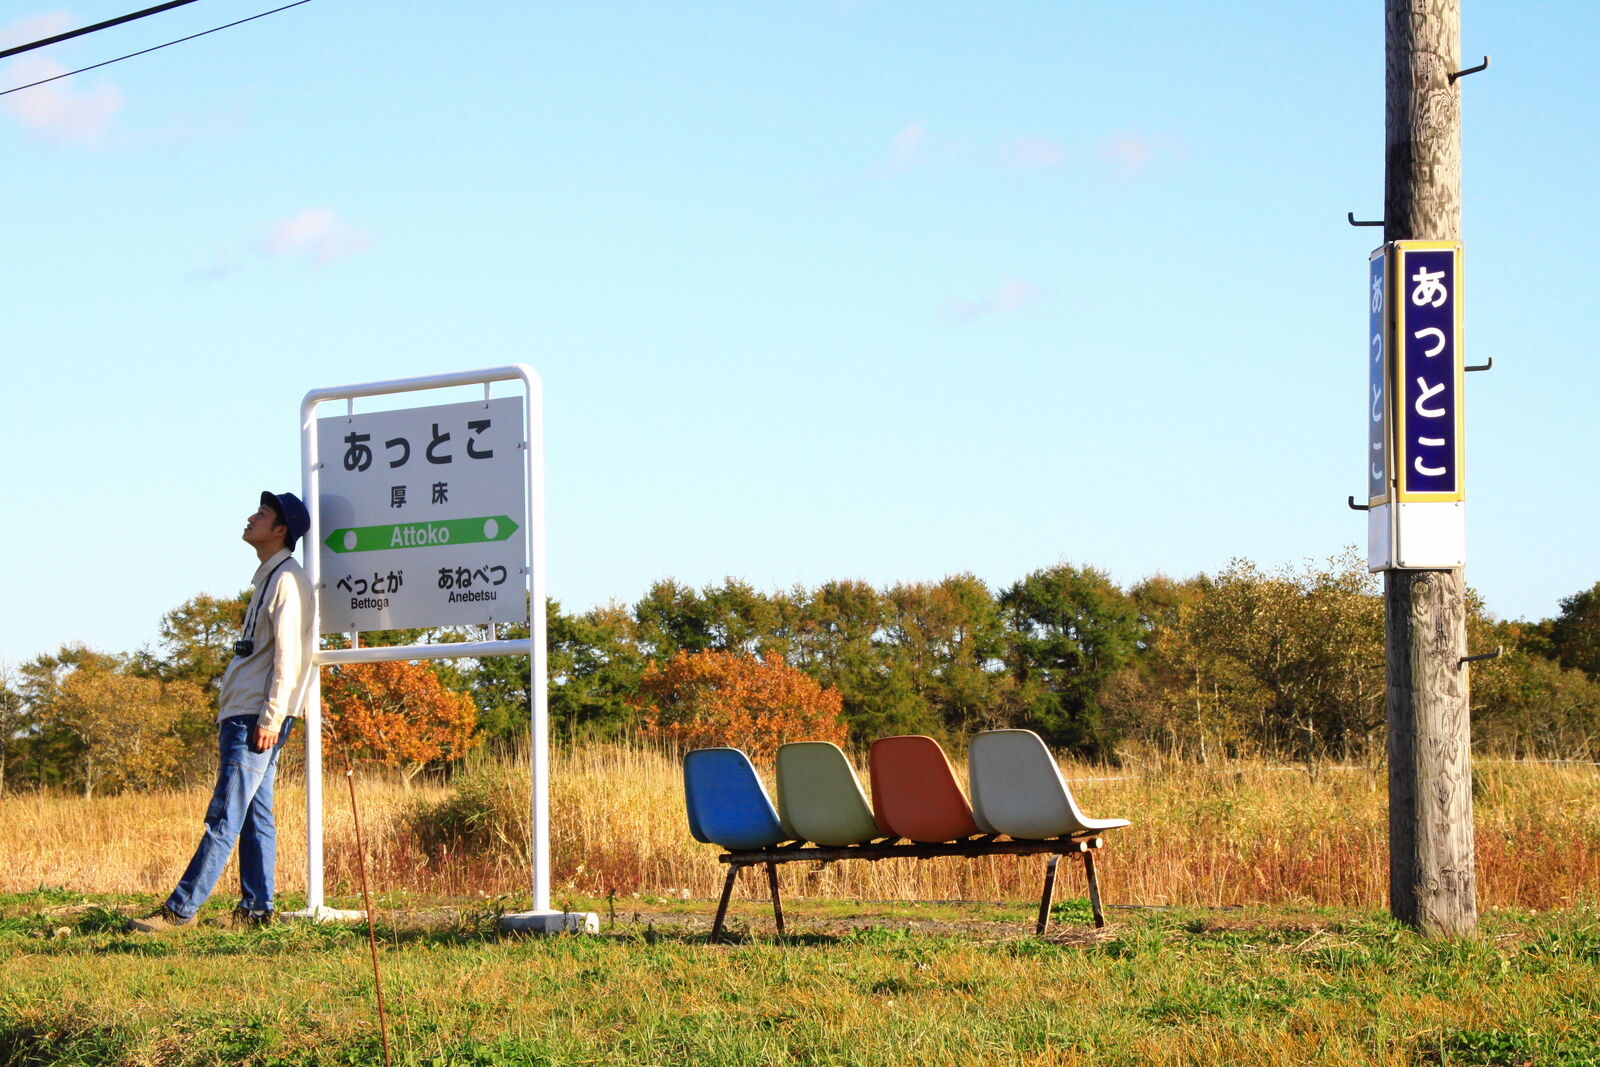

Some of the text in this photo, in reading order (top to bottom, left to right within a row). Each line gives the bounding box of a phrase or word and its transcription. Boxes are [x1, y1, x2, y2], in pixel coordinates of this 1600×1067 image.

[390, 481, 448, 509] 厚床
[390, 523, 449, 547] Attoko
[437, 565, 507, 590] あねべつ
[351, 596, 389, 611] Bettoga
[448, 590, 497, 603] Anebetsu
